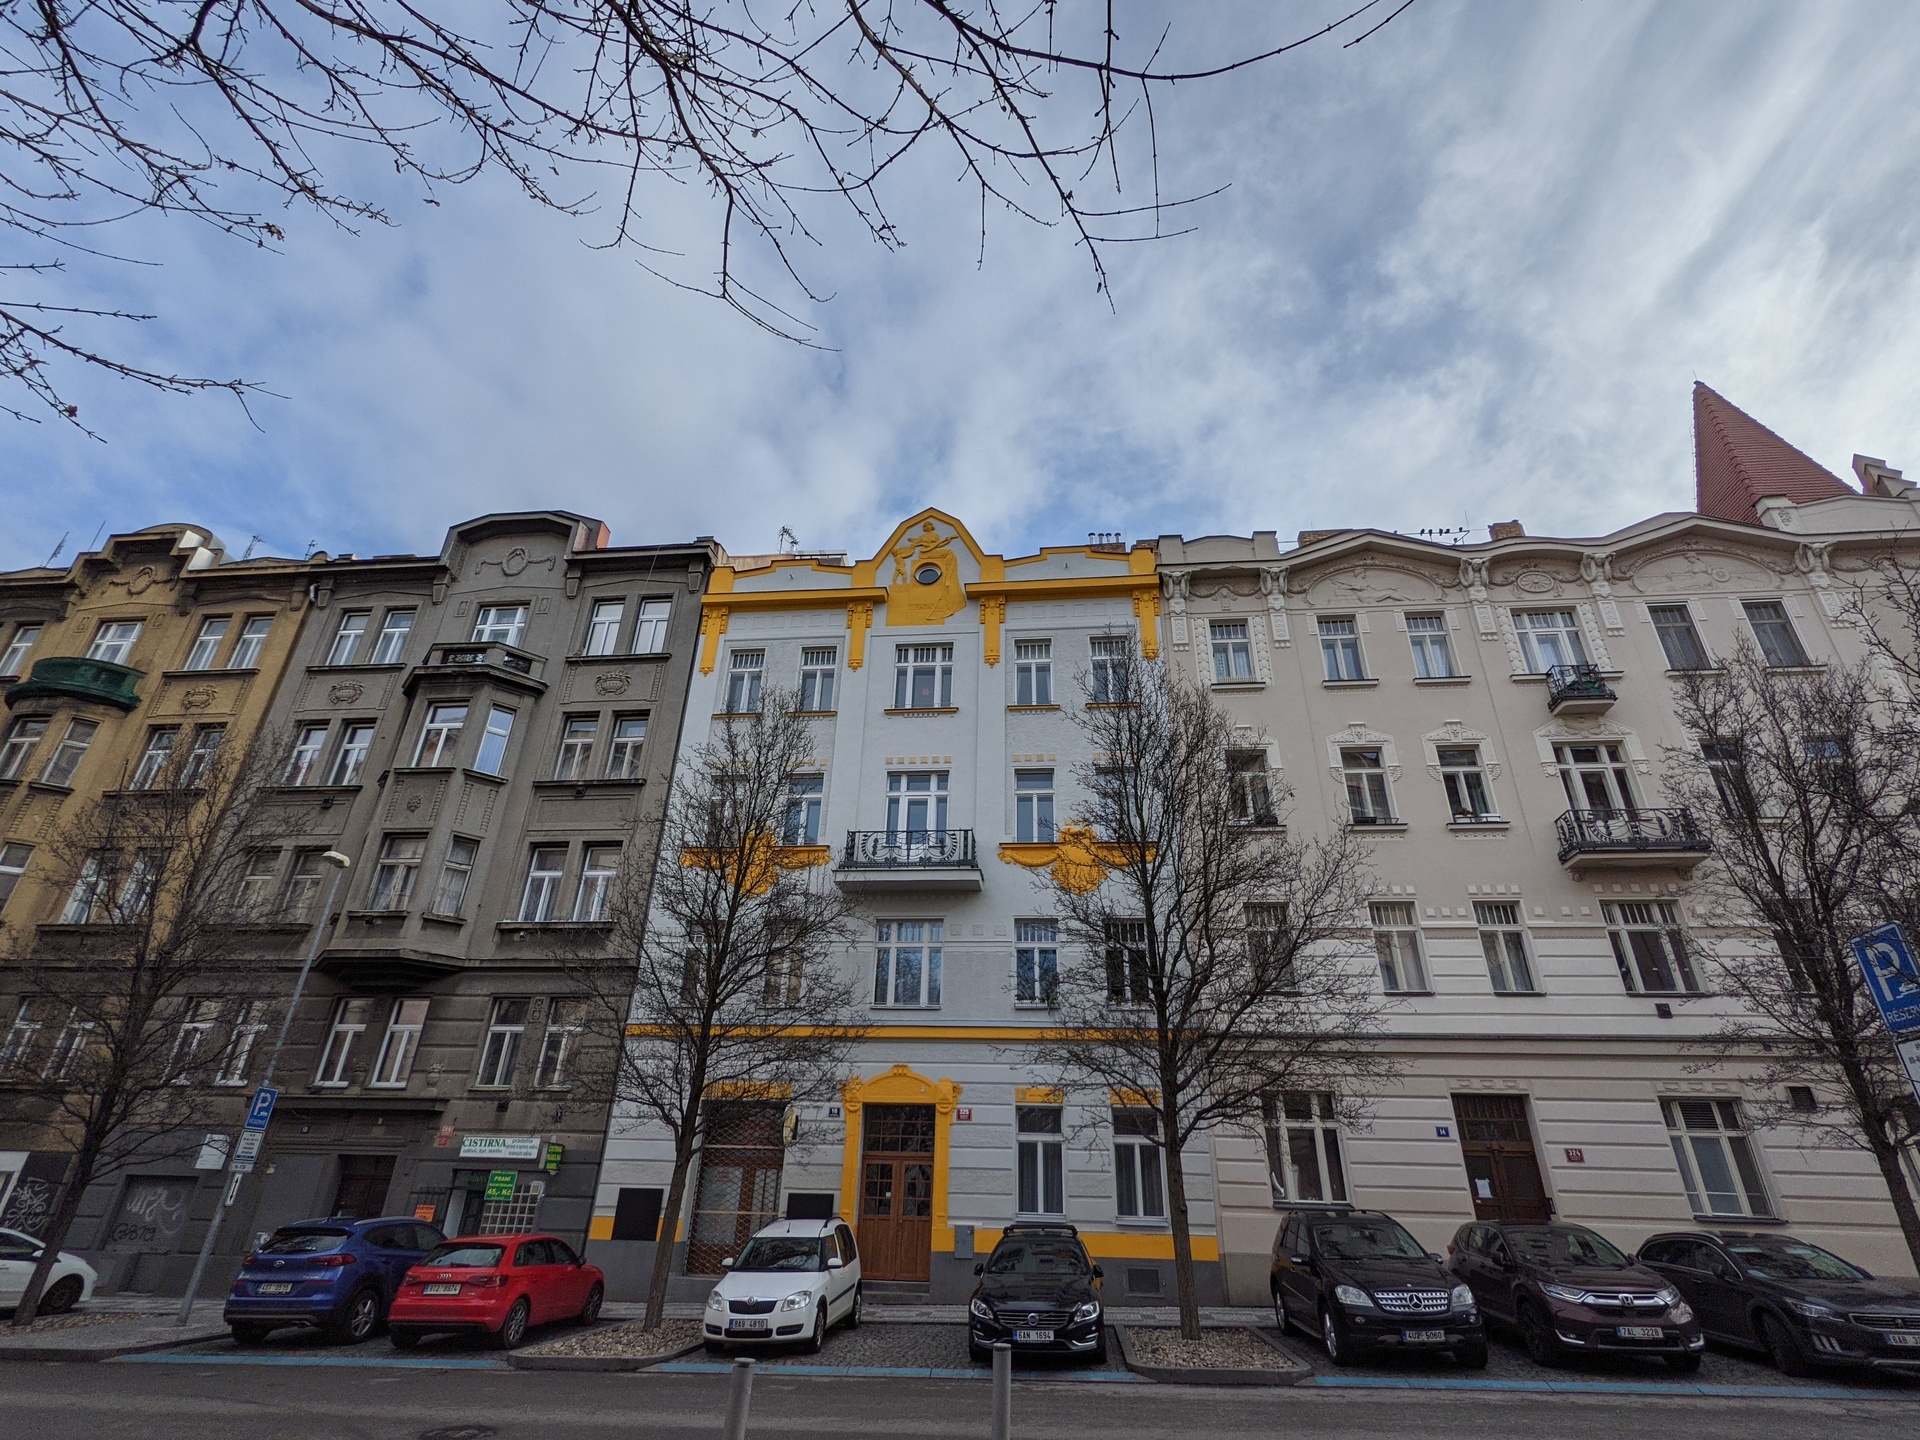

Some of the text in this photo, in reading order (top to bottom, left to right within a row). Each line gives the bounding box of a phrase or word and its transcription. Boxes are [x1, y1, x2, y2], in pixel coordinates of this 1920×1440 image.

[1864, 942, 1900, 1002] P
[253, 1092, 272, 1116] P
[462, 1136, 506, 1148] ČISTÍRNA
[429, 1284, 439, 1292] 9T2
[1018, 1331, 1051, 1339] 6AN 1694
[1622, 1328, 1660, 1336] 7AL 3228
